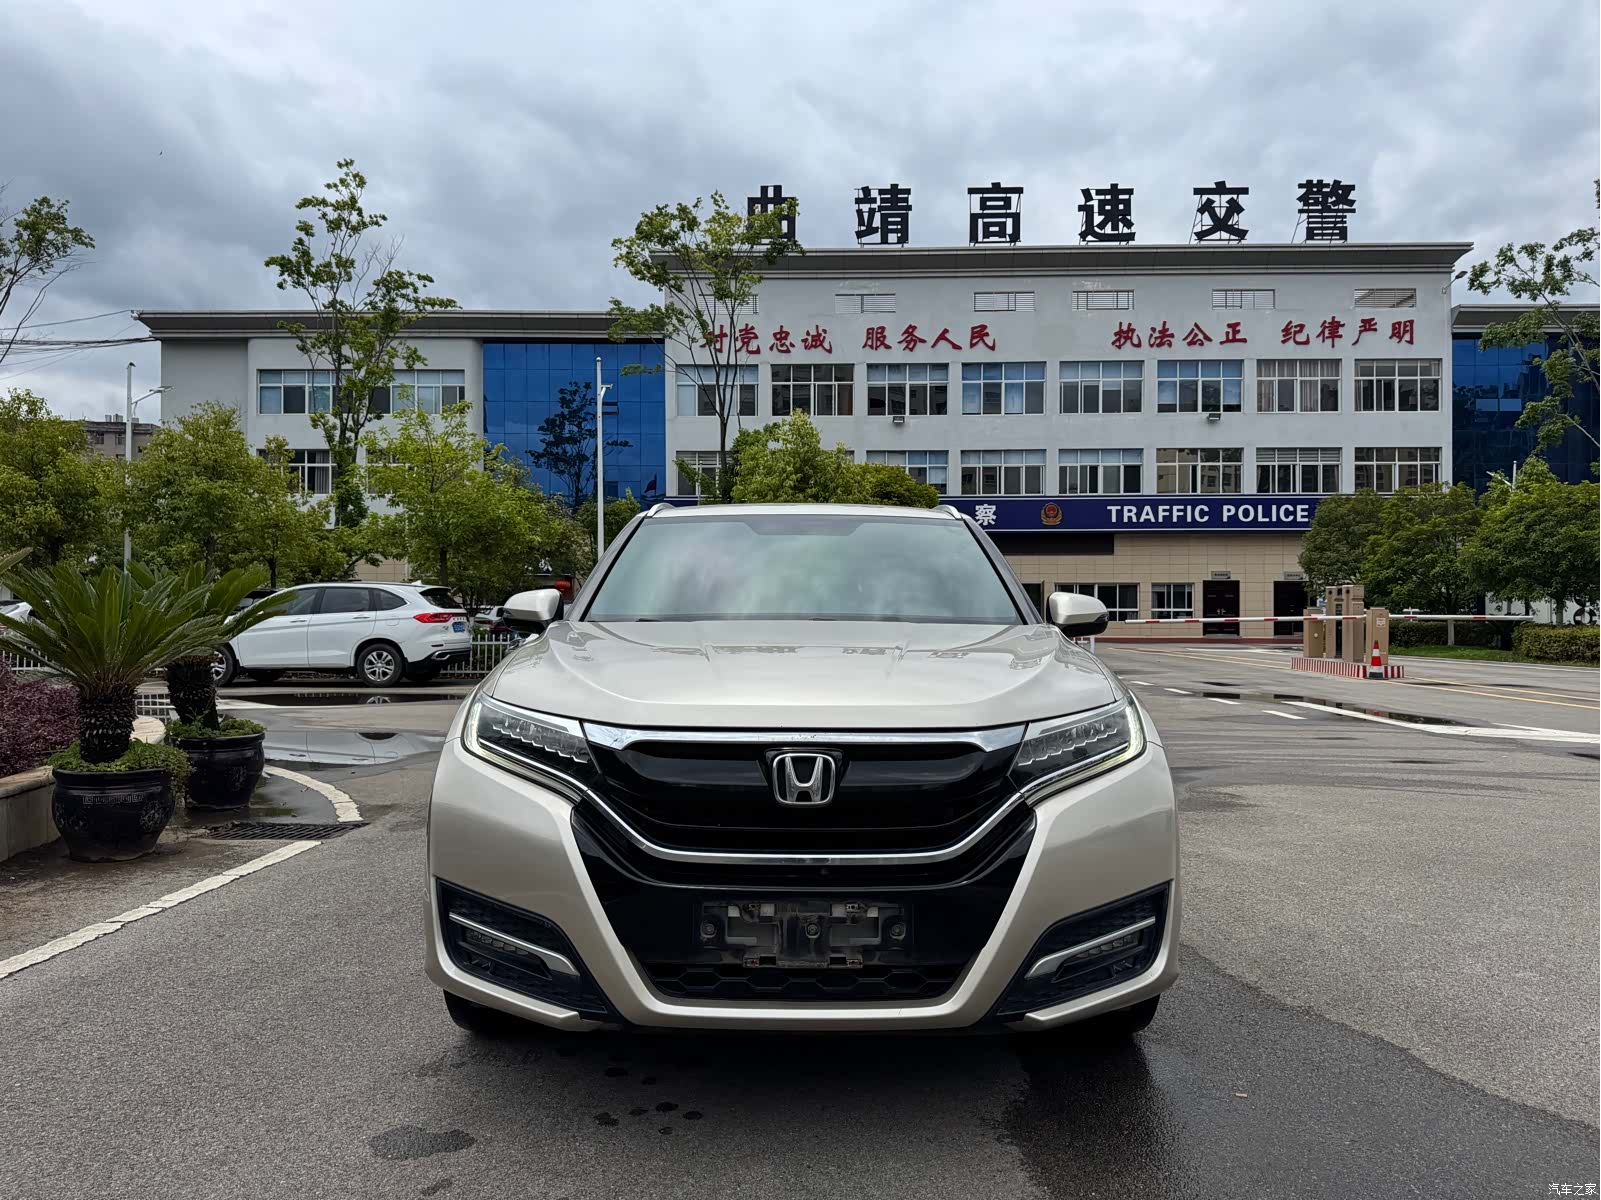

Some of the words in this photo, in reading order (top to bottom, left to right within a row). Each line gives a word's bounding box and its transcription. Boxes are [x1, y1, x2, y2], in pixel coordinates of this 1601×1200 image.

[747, 179, 1357, 244] 曲靖高速交警
[702, 323, 833, 354] 对党忠诚
[862, 324, 997, 351] 服务人民
[1111, 321, 1249, 349] 执法公正
[1280, 316, 1416, 346] 纪律严明
[975, 503, 997, 526] 察
[1106, 504, 1210, 523] TRAFFIC
[1222, 503, 1310, 522] POLICE
